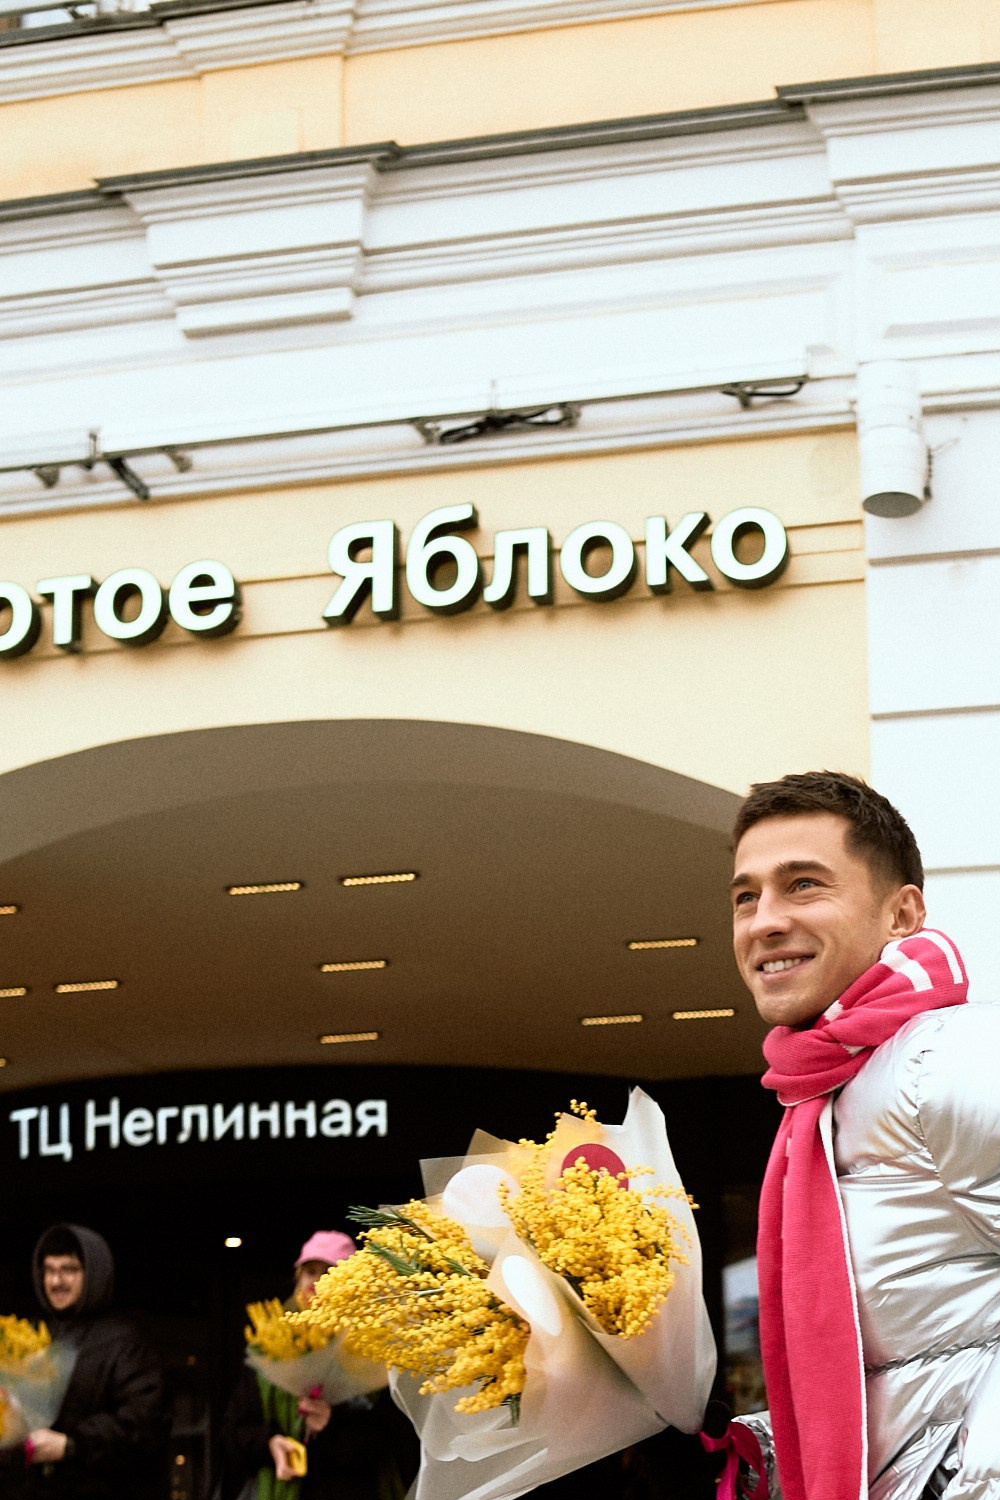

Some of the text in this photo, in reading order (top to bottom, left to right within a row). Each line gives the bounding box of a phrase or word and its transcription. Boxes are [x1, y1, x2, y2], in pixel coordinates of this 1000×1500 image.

[322, 502, 789, 621] Яблоко
[9, 1096, 389, 1163] ТЦ Неглинная
